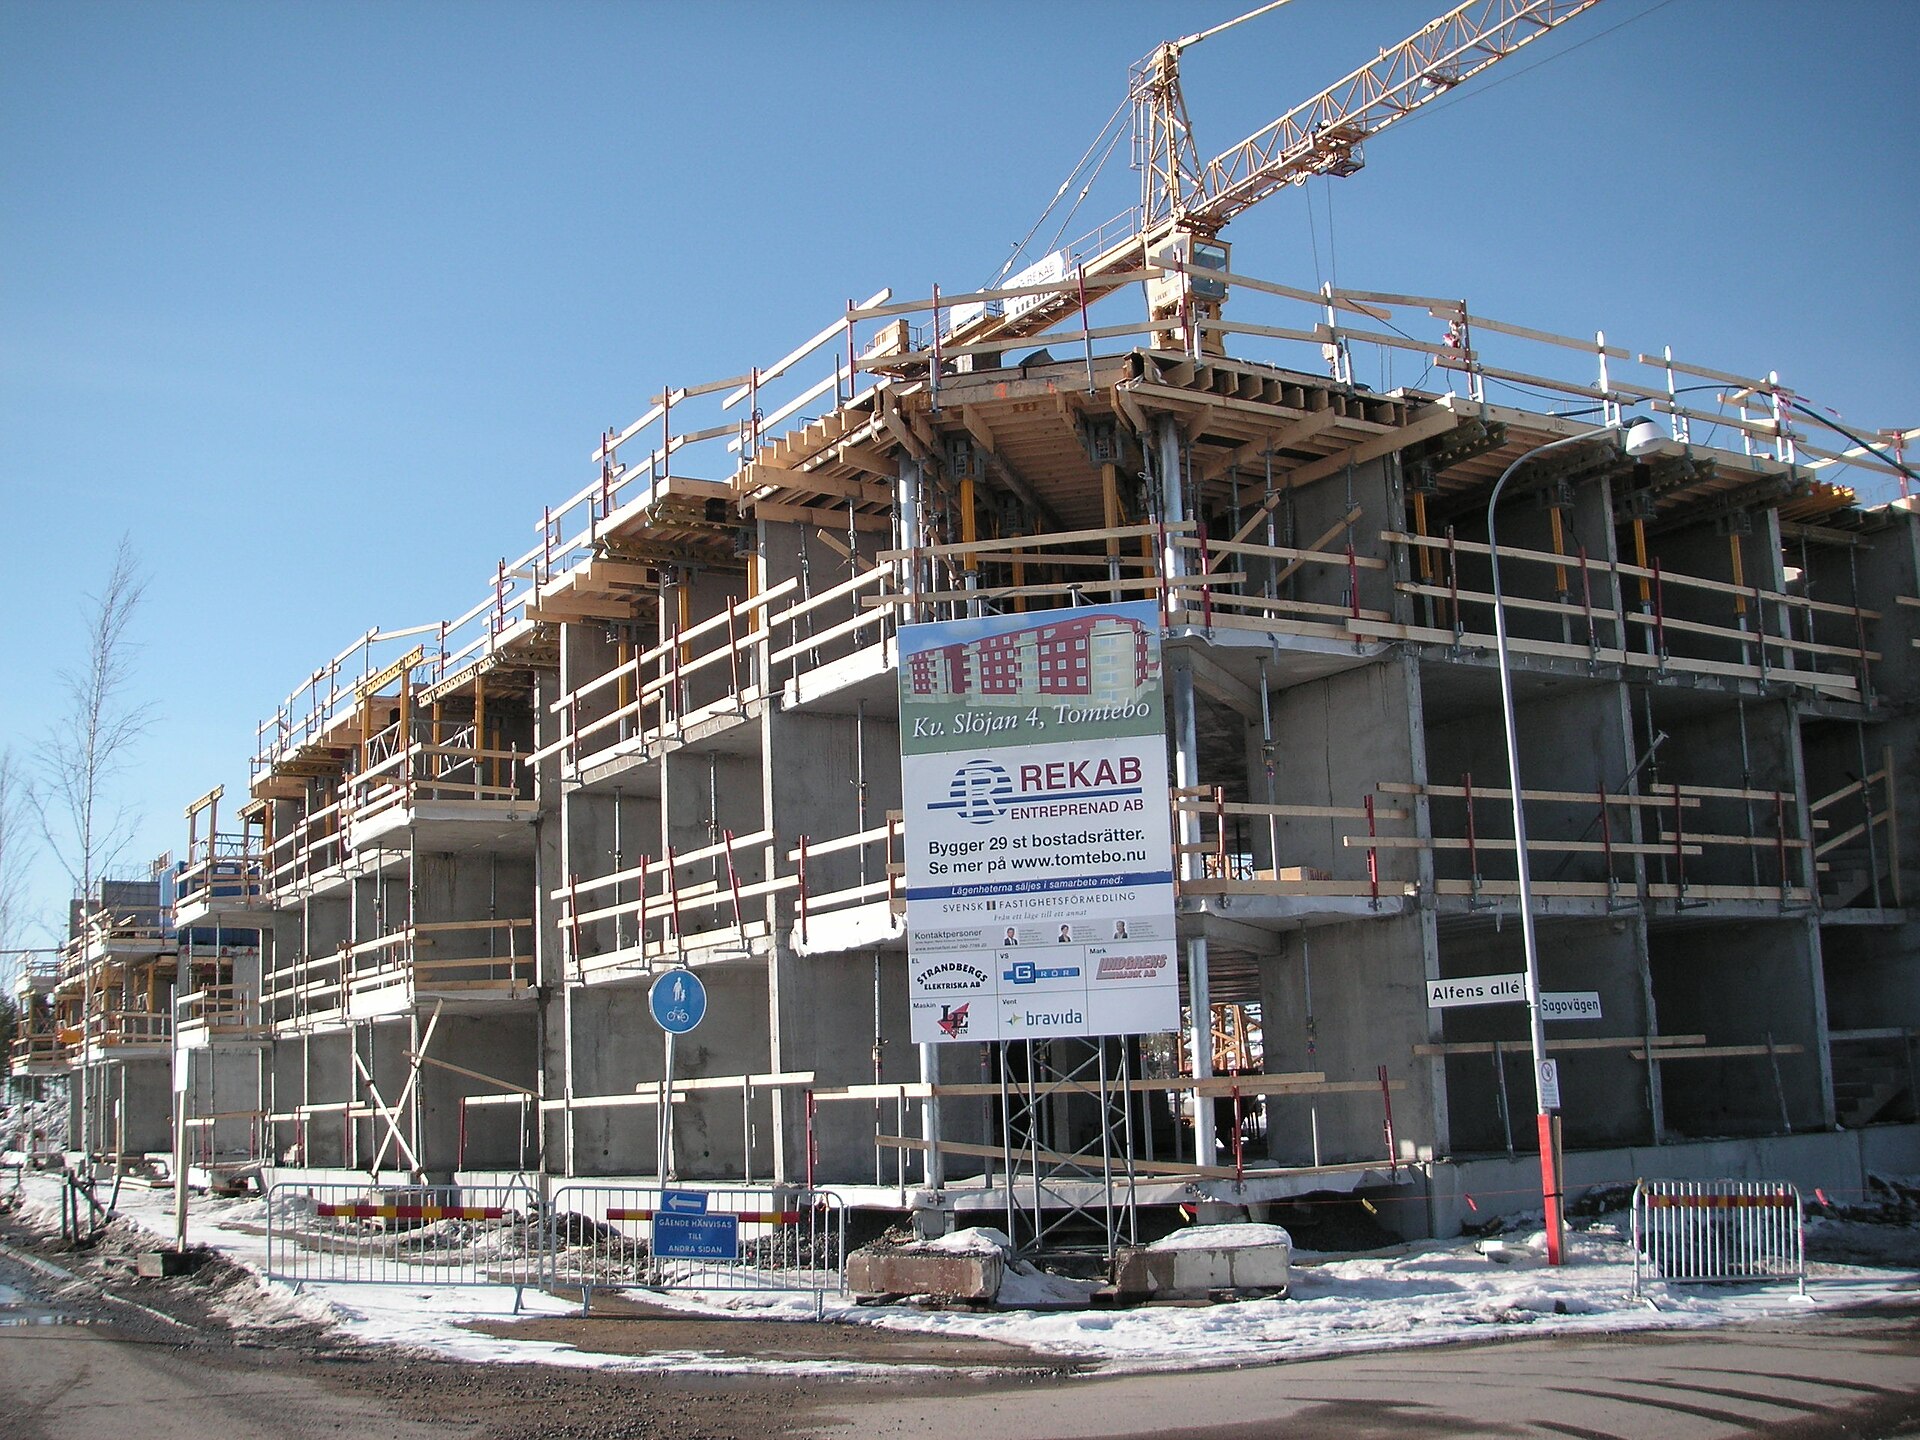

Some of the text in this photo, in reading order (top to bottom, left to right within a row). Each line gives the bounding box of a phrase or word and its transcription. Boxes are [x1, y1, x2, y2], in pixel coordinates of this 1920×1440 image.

[913, 698, 1150, 738] Kv. Slöjan 4, Tomtebo
[1020, 756, 1142, 792] REKAB
[1011, 799, 1144, 820] ENTREPRENAD AB
[929, 828, 1144, 858] Bygger 29 st bostadsrätter.
[929, 848, 1146, 874] Se mer på www.tomtebo.nu
[1049, 879, 1097, 888] samarbete
[1100, 876, 1124, 884] med:
[943, 891, 1136, 912] SVENSK FASTIGHETSFÖRMEDLING
[914, 930, 982, 939] Kontaktpersoner
[917, 963, 988, 984] STRANDBERGS
[924, 982, 968, 990] ELEKTRISKA
[1432, 980, 1520, 1000] Alfens allé
[1543, 999, 1598, 1014] Sagovägen
[1026, 1009, 1082, 1025] bravida
[659, 1218, 689, 1227] GÅENDE
[688, 1232, 702, 1240] TILL
